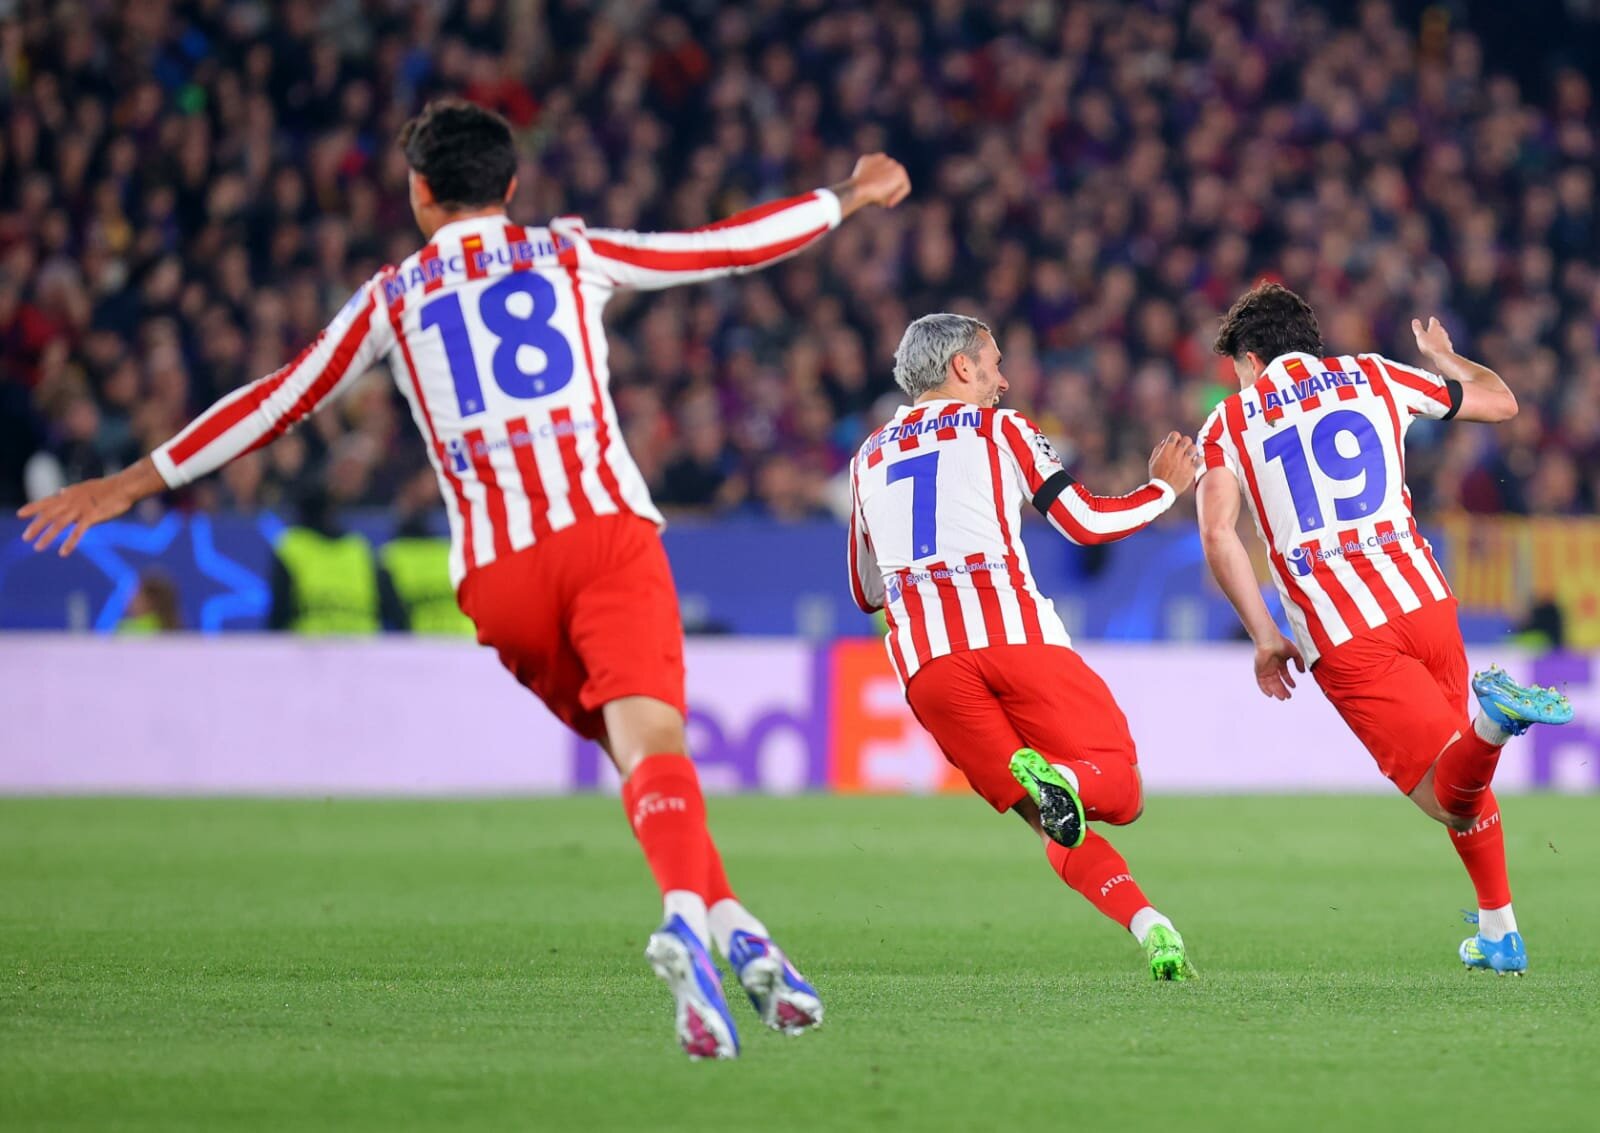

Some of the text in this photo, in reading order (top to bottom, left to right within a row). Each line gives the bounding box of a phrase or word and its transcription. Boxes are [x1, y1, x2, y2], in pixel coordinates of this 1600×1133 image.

[384, 254, 465, 304] MARC
[420, 271, 574, 418] 18
[1244, 370, 1367, 419] J. ALVAREZ
[855, 411, 983, 472] RIEZMANN
[1263, 409, 1387, 533] 19
[886, 450, 940, 561] 7
[1316, 530, 1412, 560] Save the Children
[906, 561, 1008, 587] Save the Children
